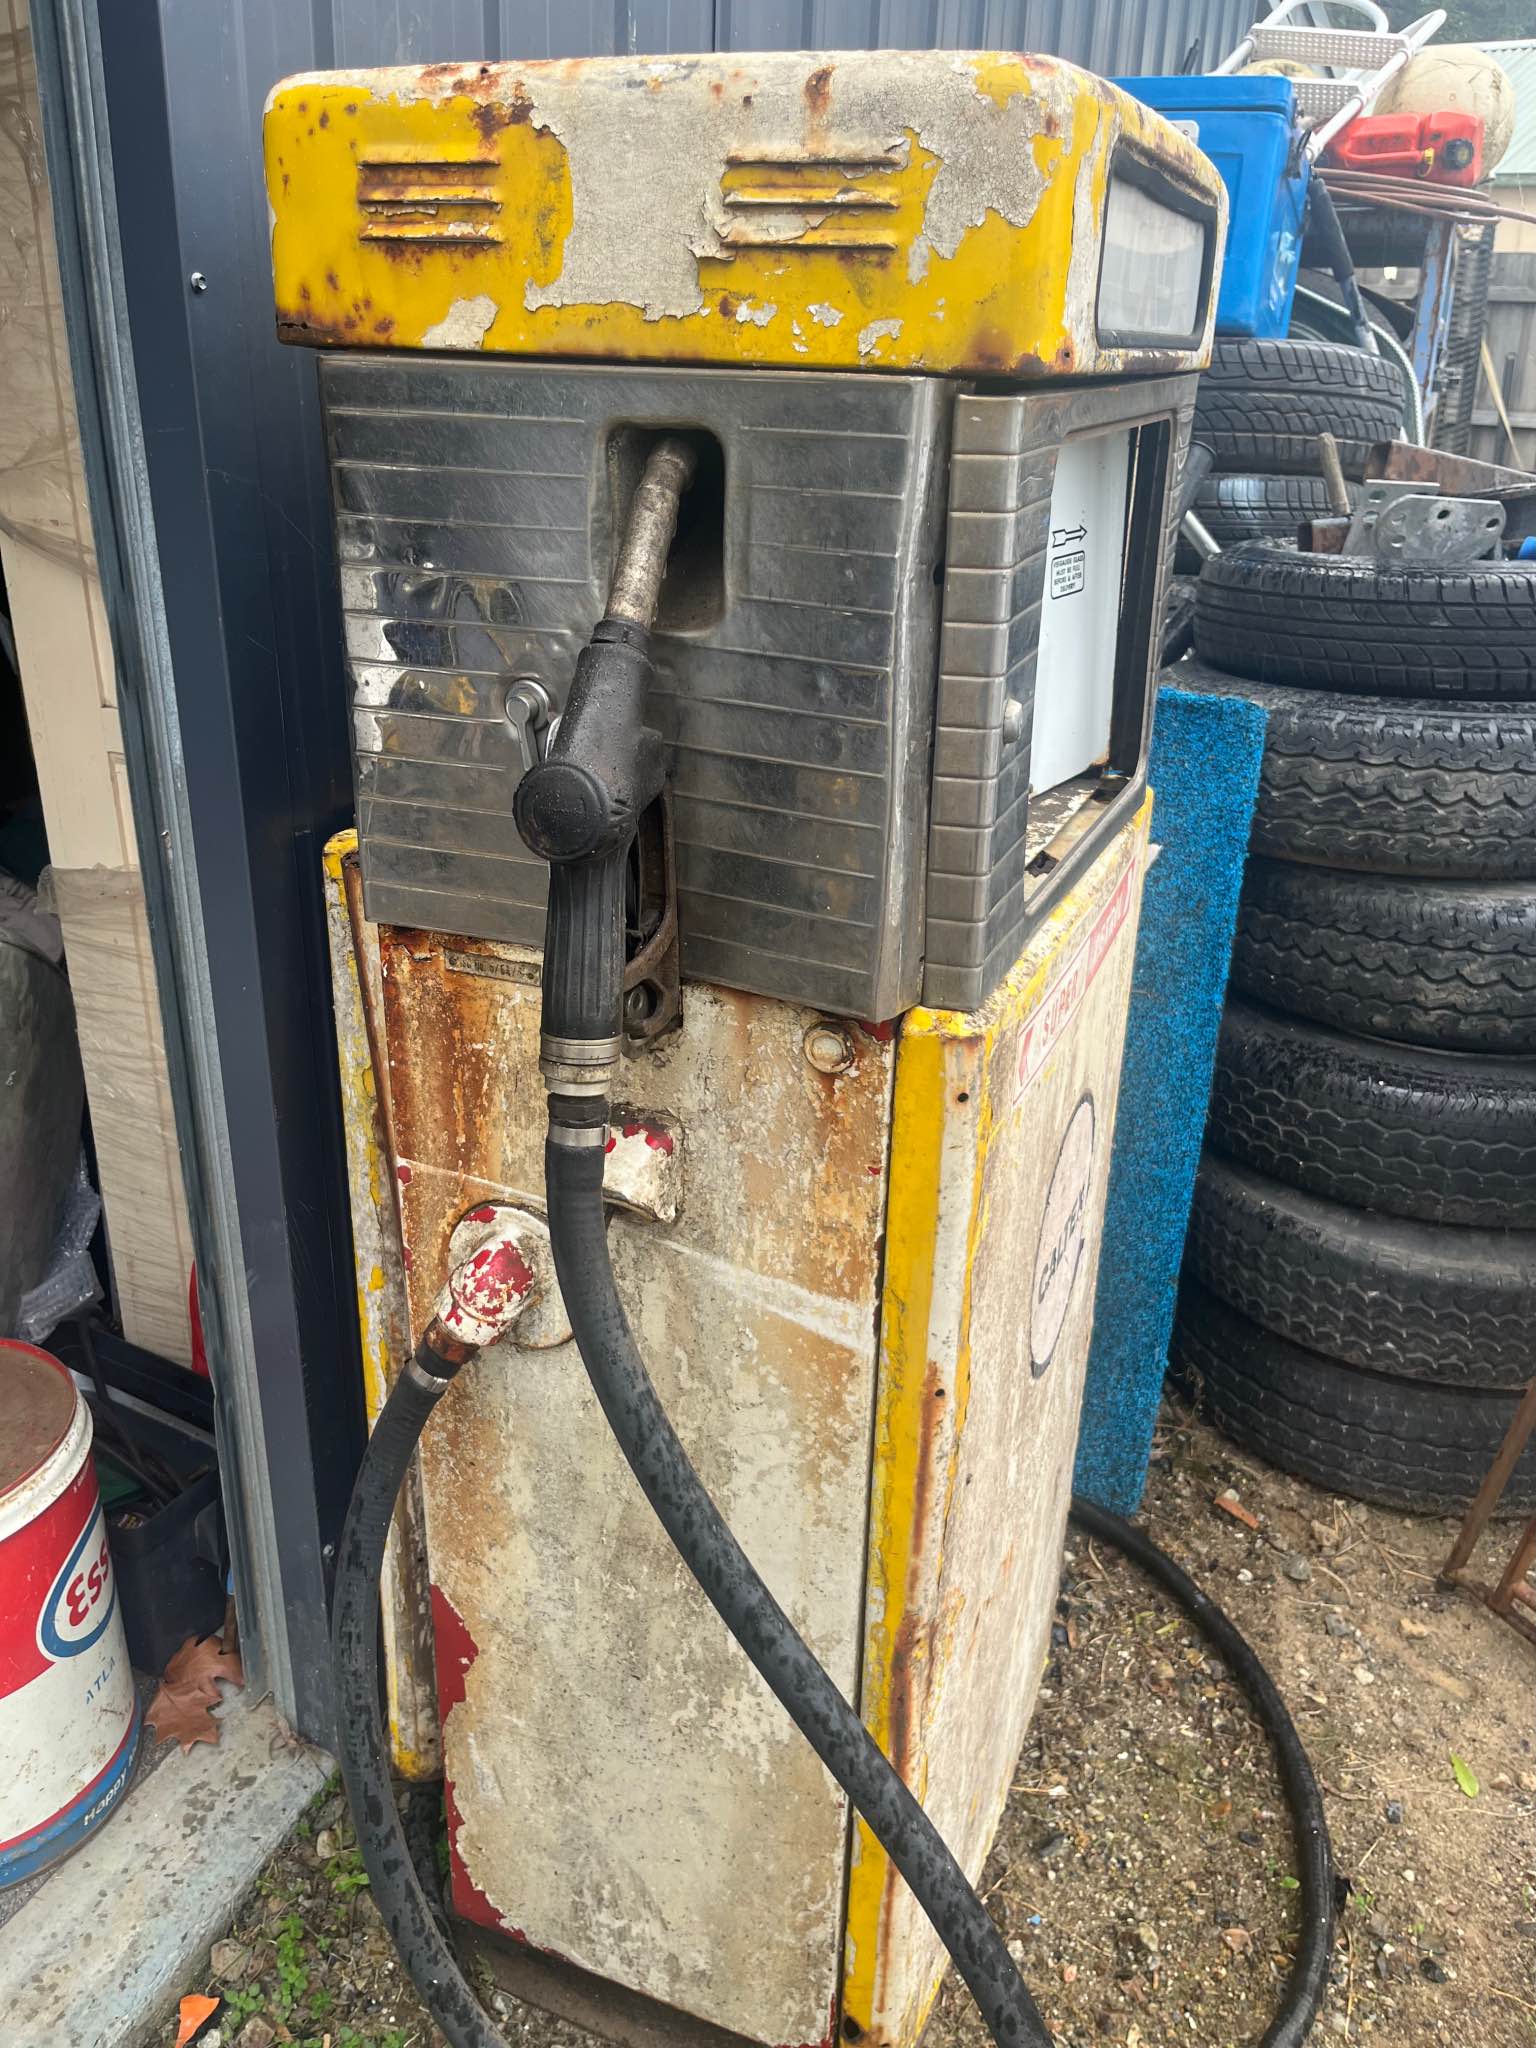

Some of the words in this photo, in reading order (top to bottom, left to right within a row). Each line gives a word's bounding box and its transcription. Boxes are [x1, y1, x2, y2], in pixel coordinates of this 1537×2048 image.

[1042, 968, 1079, 1047] SUPER
[1038, 1184, 1086, 1304] CALTEX
[86, 1656, 116, 1704] ATLA
[84, 1768, 127, 1826] Happy
